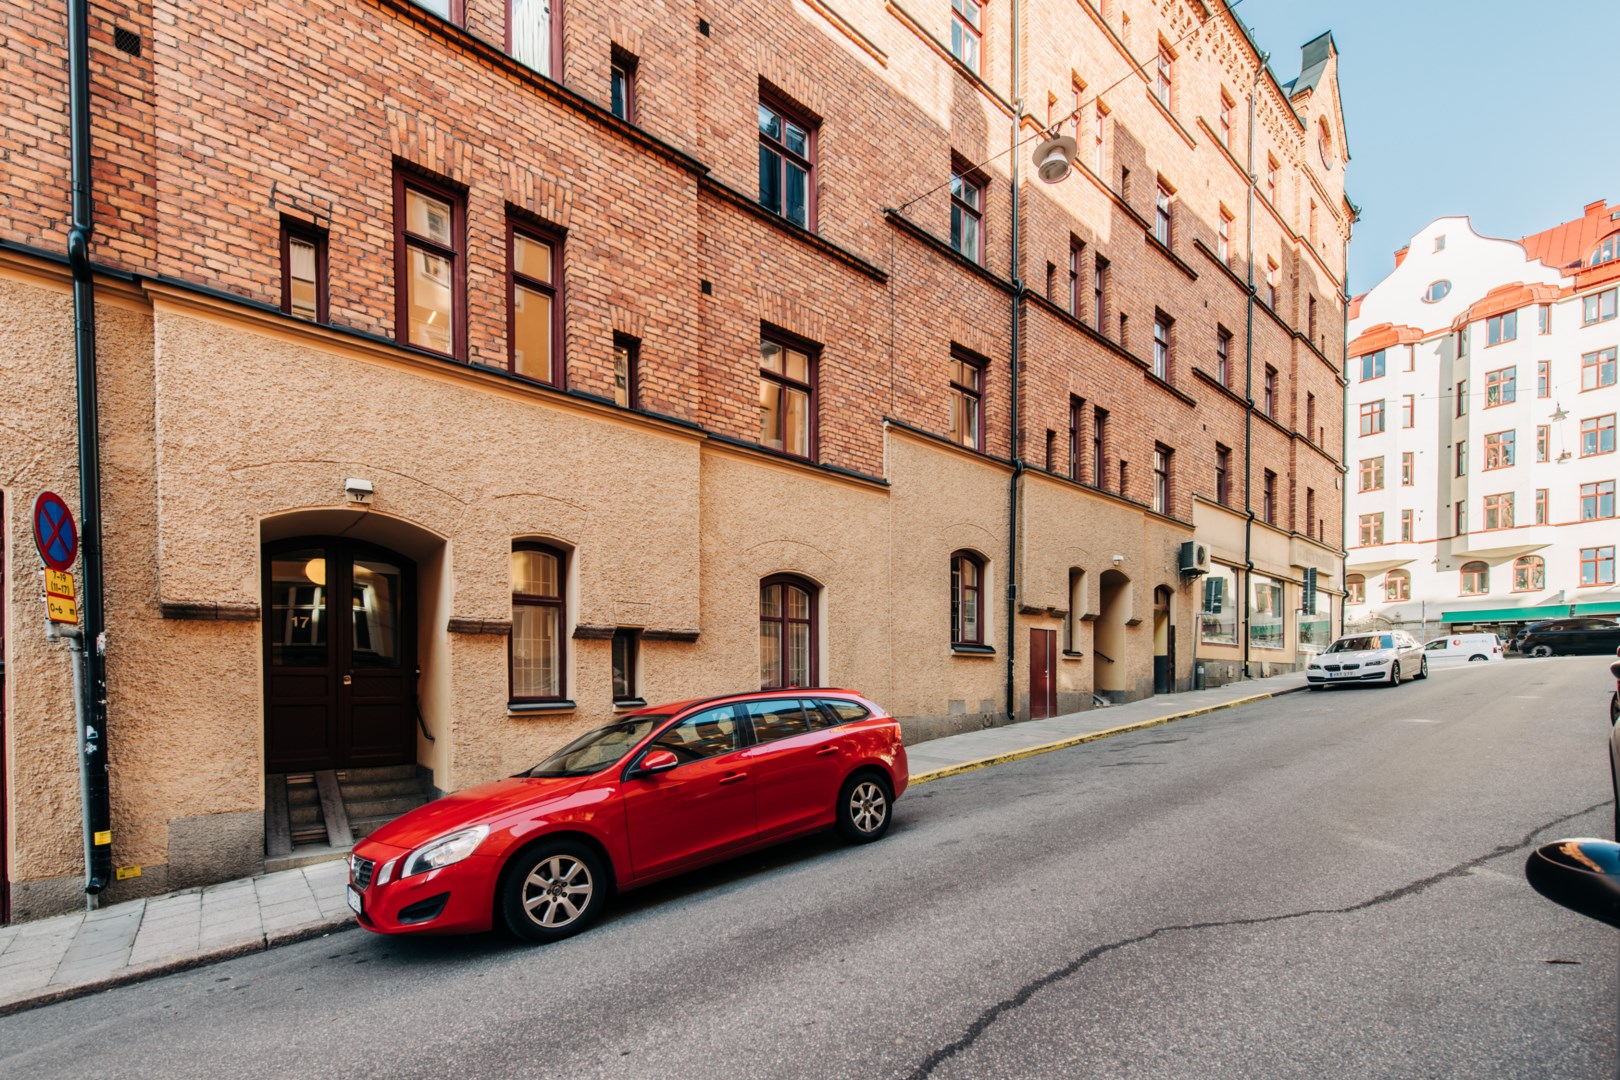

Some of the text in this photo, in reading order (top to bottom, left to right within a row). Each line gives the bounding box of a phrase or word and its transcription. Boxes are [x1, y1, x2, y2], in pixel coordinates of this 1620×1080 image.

[354, 493, 365, 501] 17
[53, 570, 67, 582] 7-19
[51, 581, 70, 595] (11-17)
[291, 616, 310, 629] 17
